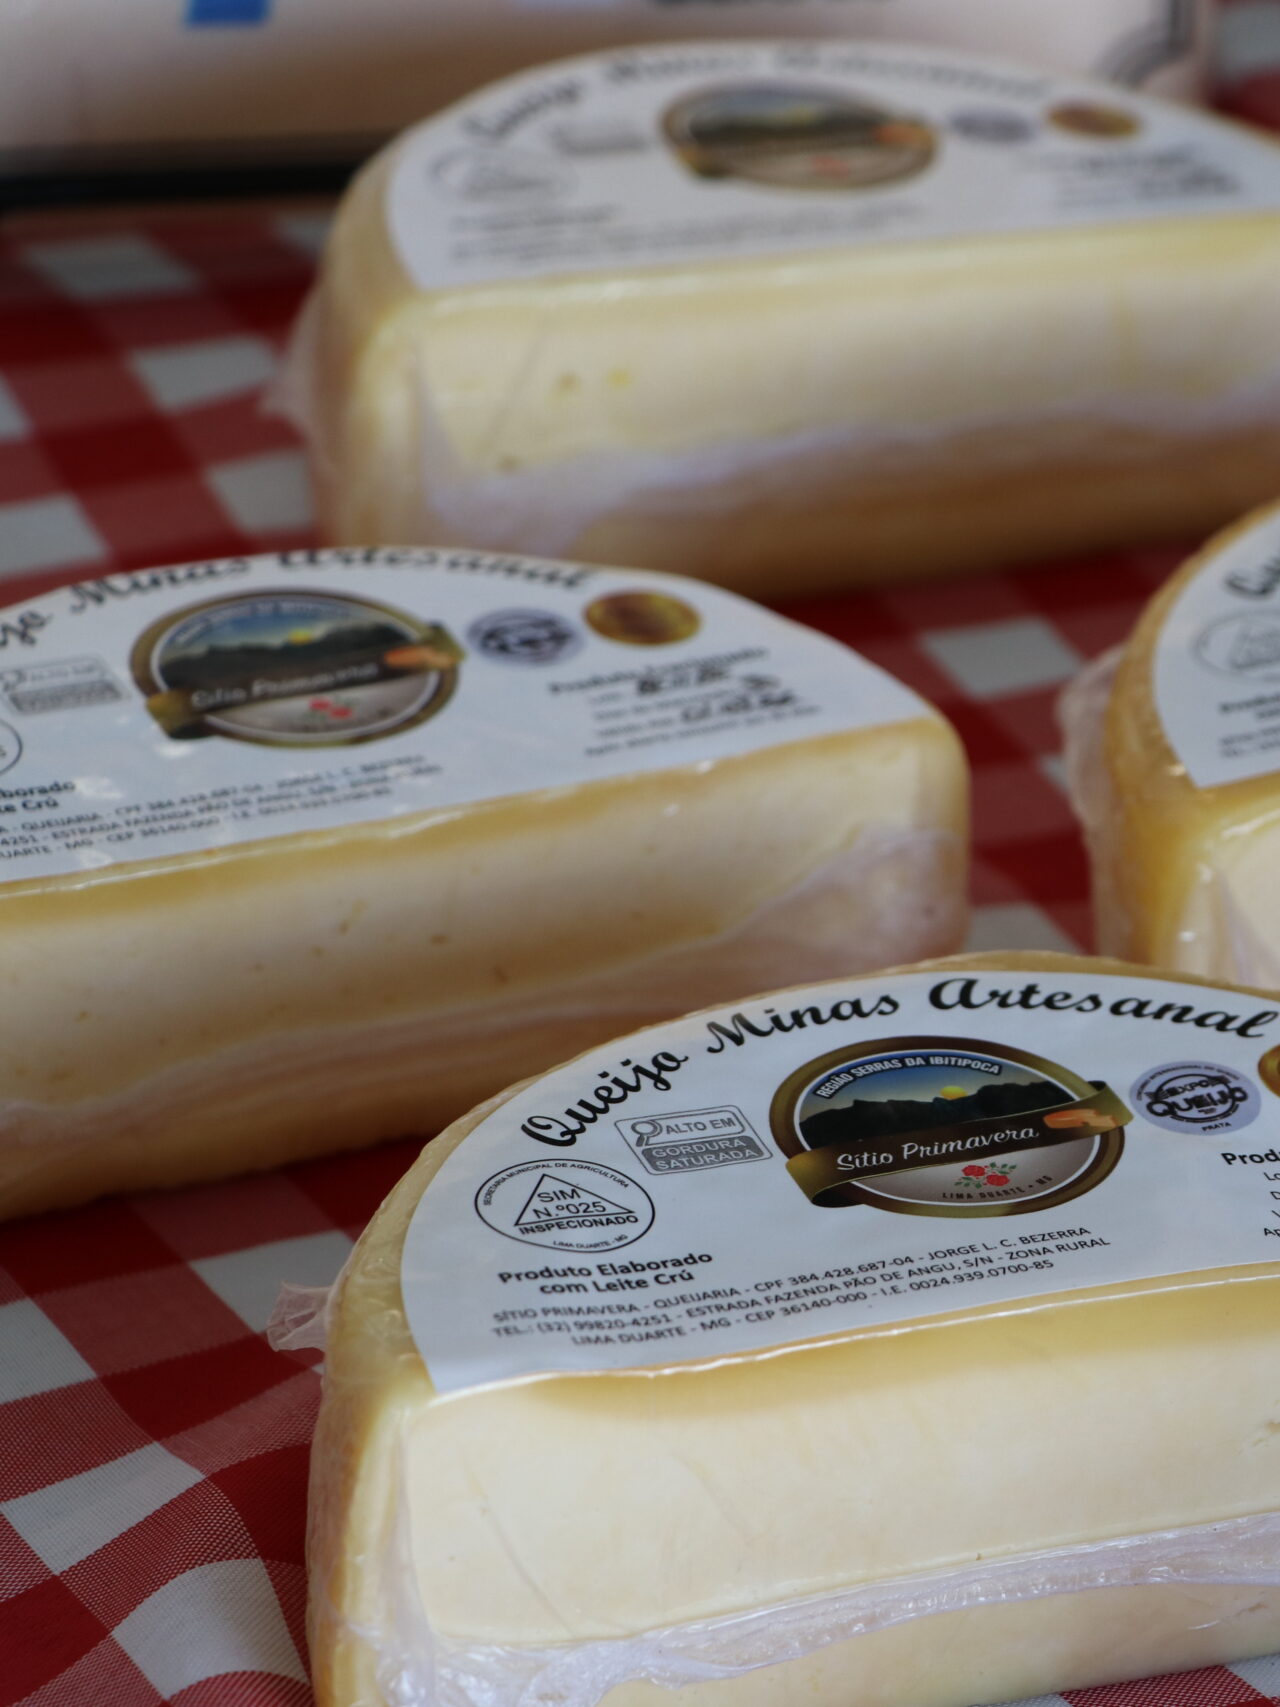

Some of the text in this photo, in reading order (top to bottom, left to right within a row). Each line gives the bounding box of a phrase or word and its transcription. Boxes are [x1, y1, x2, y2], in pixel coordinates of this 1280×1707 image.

[520, 976, 1280, 1148] Queijo Minas Artesanal
[816, 1056, 1000, 1099] REGIÃO SERRAS DA IBITIPOCA
[665, 1117, 736, 1136] ALTO EM
[651, 1137, 747, 1159] GORDURA
[654, 1148, 759, 1171] SATURADA
[835, 1126, 1040, 1172] Sítio Primavera
[537, 1188, 582, 1204] SIM
[518, 1214, 639, 1236] INSPECIONADO
[492, 1307, 538, 1323] SÍTIO
[539, 1302, 639, 1319] PRIMAVERA
[652, 1287, 742, 1310] QUEIJARIA
[753, 1279, 785, 1293] CPF
[786, 1255, 915, 1287] 384.428.687-04
[926, 1244, 982, 1261] JORGE
[982, 1242, 998, 1252] L.
[999, 1238, 1017, 1248] C.
[1018, 1227, 1092, 1246] BEZERRA
[497, 1251, 714, 1284] Produto Elaborado
[539, 1269, 695, 1295] com Leite Crú
[537, 1320, 571, 1334] (32)
[572, 1313, 673, 1333] 99820-4251
[684, 1298, 762, 1319] ESTRADA
[763, 1283, 841, 1305] FAZENDA
[842, 1275, 878, 1290] PÃO
[879, 1272, 905, 1284] DE
[907, 1262, 962, 1279] ANGU,
[963, 1255, 994, 1268] S/N
[1004, 1245, 1055, 1261] ZONA
[1056, 1236, 1111, 1253] RURAL
[570, 1334, 617, 1347] LIMA
[619, 1326, 687, 1344] DUARTE
[699, 1315, 732, 1332] MG
[744, 1309, 776, 1324] CEP
[779, 1290, 869, 1317] 36140-000
[880, 1285, 908, 1297] I.E.
[909, 1258, 1055, 1291] 0024.939.0700-85
